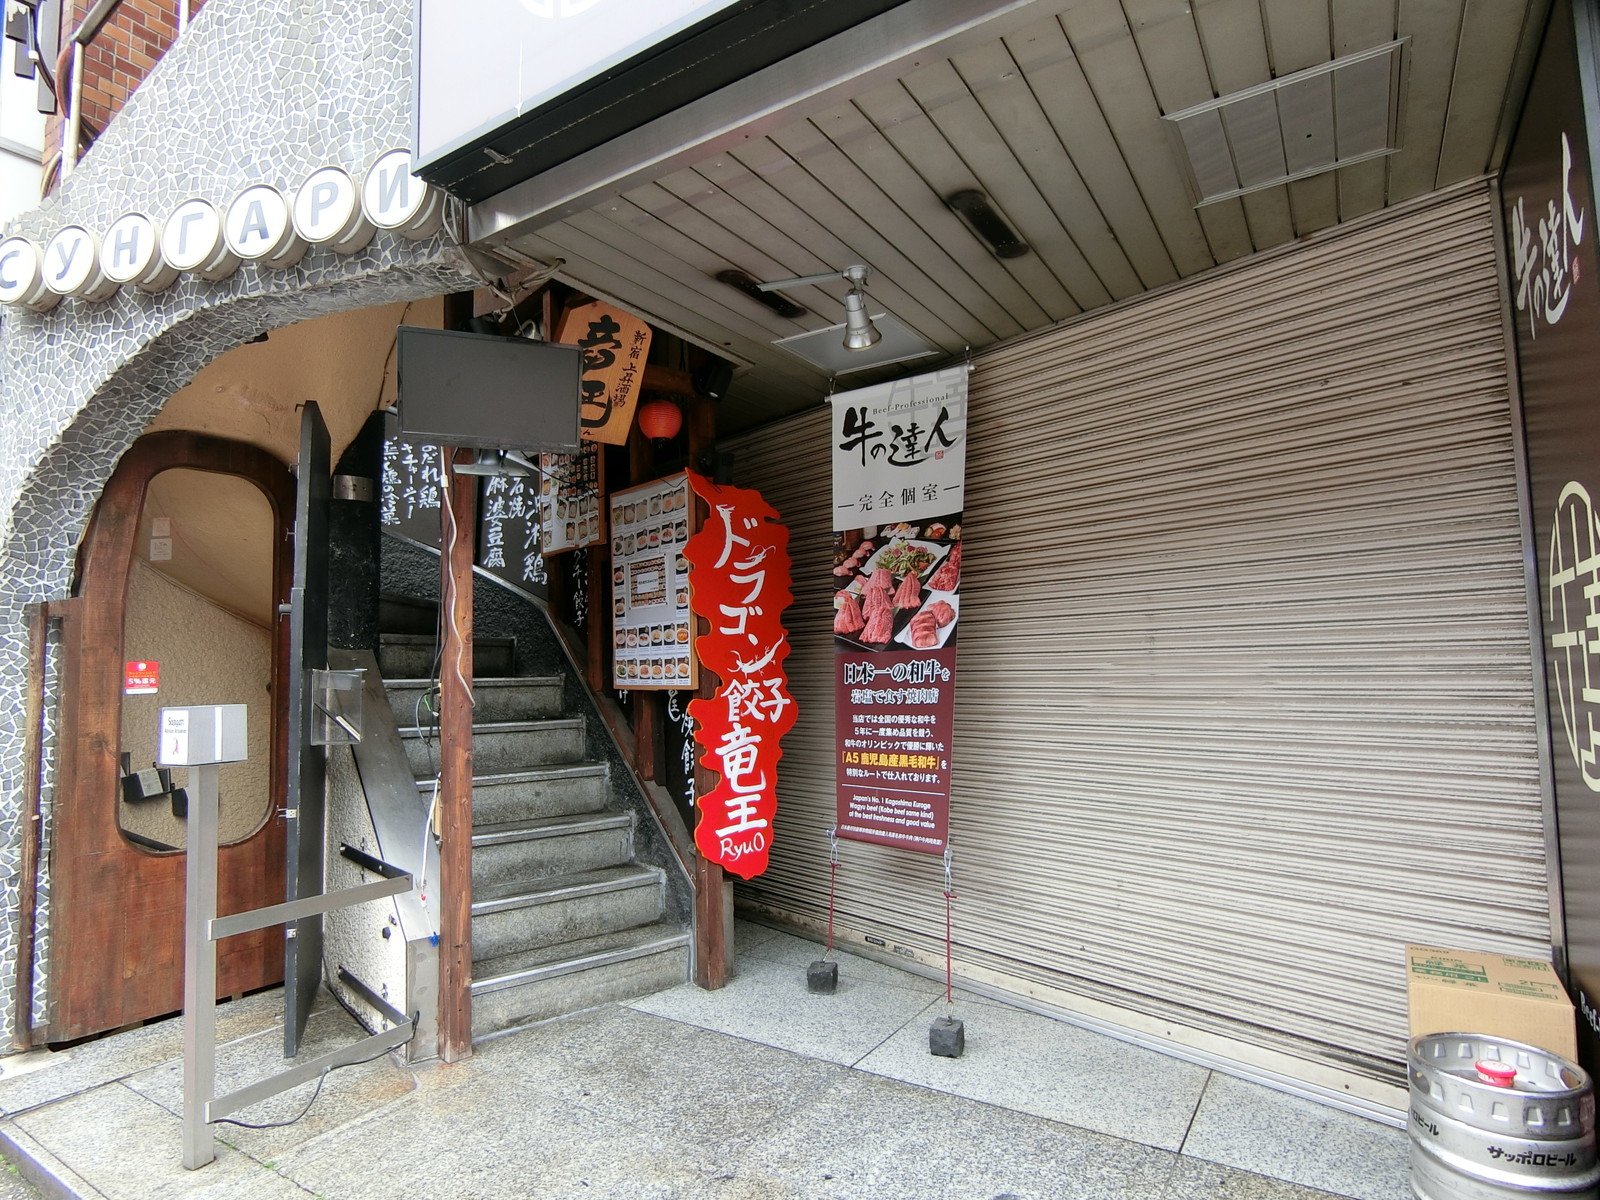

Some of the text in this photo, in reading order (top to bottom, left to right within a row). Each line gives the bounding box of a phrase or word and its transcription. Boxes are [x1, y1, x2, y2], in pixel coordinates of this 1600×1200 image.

[0, 172, 409, 290] СУНГАРИ
[1512, 131, 1584, 341] 牛の達人
[629, 330, 648, 360] 新宿
[872, 393, 949, 416] Beef-Professional
[839, 406, 958, 467] 牛の達人
[484, 476, 509, 568] 麻婆豆腐
[843, 659, 951, 685] 日本一の和牛を
[721, 677, 791, 724] 餃子
[851, 688, 940, 705] 岩塩で食す焼肉店
[714, 723, 768, 838] 竜王
[846, 767, 941, 784] 特別なルートで仕入れております。
[849, 802, 866, 811] Wagyu
[885, 797, 912, 807] Kagoshima
[895, 816, 906, 825] and
[905, 818, 920, 827] good
[920, 820, 936, 829] value
[1487, 1145, 1577, 1167] サッポロビール
